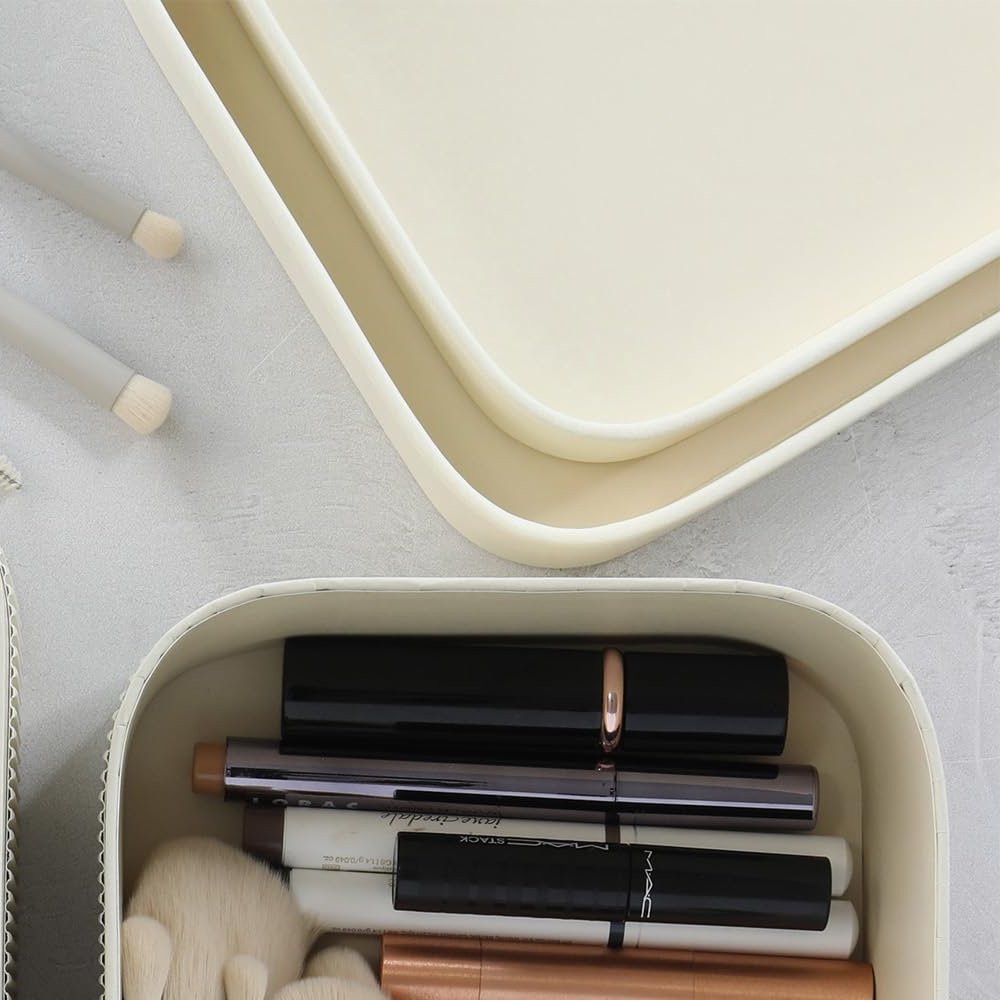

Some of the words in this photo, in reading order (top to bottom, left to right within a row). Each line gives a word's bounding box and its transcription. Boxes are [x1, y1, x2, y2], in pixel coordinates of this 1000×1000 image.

[460, 836, 505, 845] STACK
[508, 838, 609, 850] MAC
[641, 850, 653, 918] MAC
